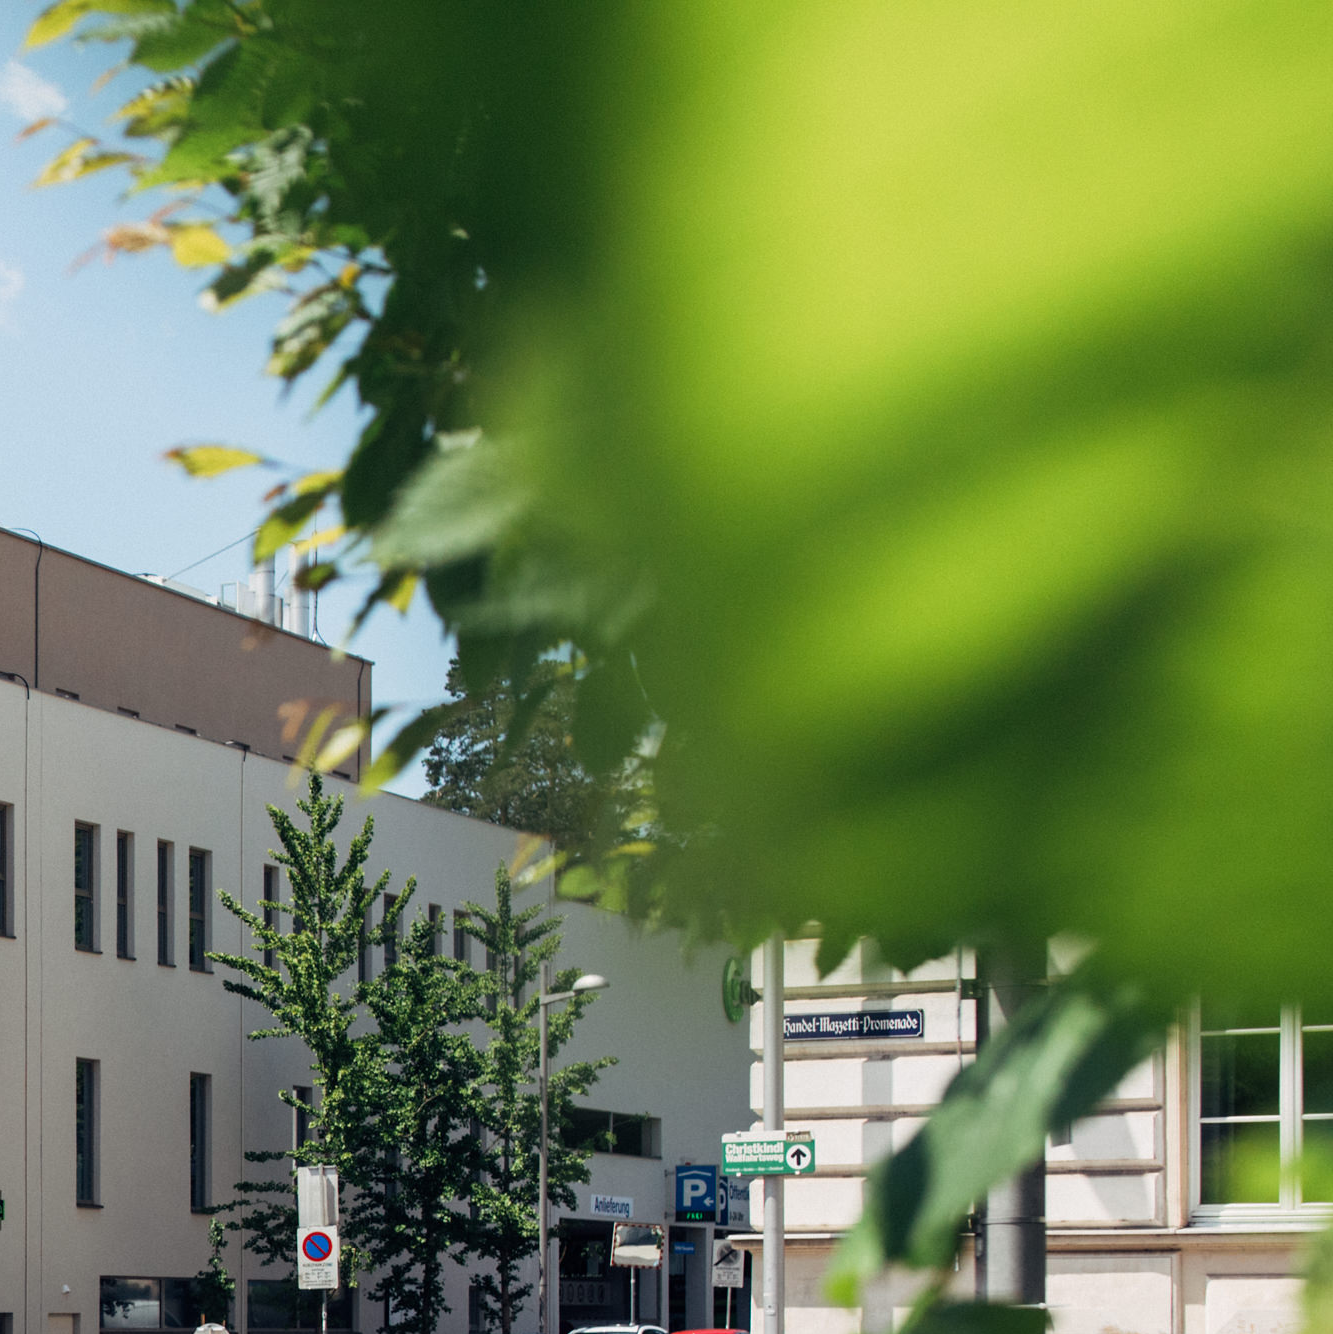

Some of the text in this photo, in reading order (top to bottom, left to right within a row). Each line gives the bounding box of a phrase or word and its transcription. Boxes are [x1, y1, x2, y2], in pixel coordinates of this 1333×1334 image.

[725, 1142, 784, 1154] Christkindl
[725, 1153, 784, 1163] Wallfahrtsweg
[683, 1178, 707, 1207] P
[595, 1196, 630, 1218] Anlieferung
